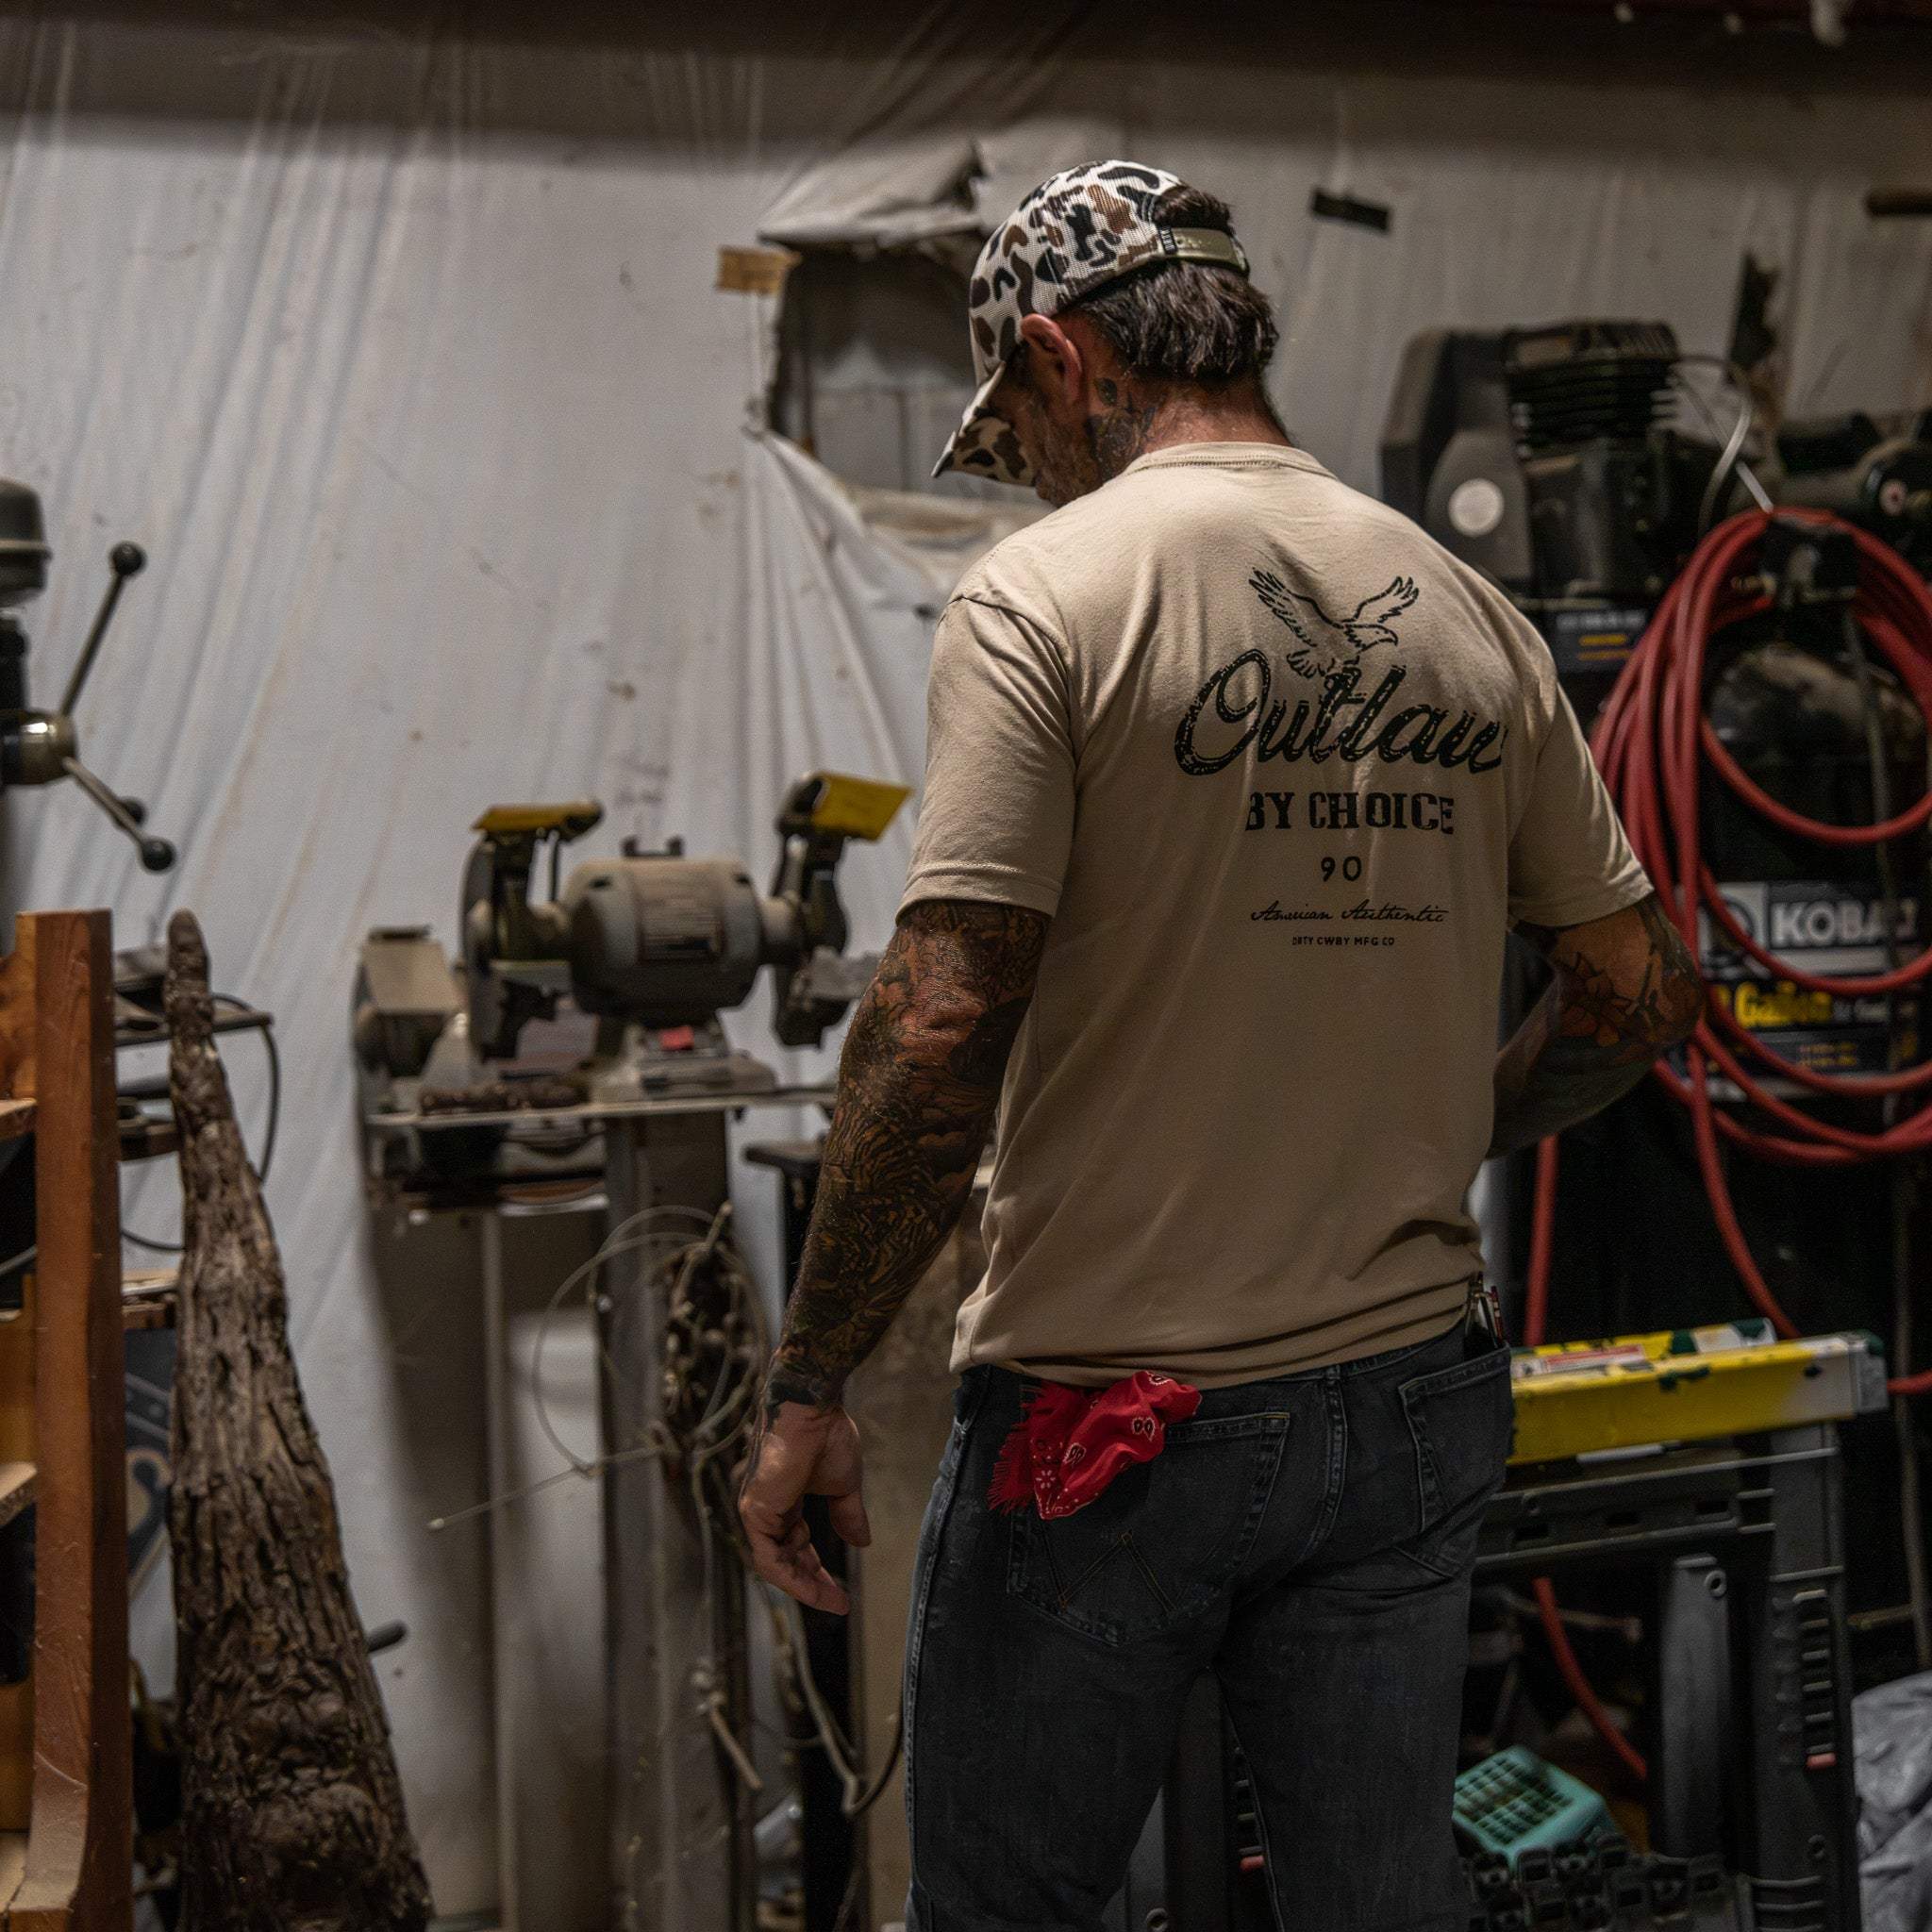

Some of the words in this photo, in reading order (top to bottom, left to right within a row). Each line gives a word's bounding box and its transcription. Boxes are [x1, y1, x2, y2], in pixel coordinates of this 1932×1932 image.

[1174, 648, 1508, 776] Outlaw
[1245, 791, 1295, 831] BY
[1308, 791, 1455, 835] CHOICE
[1320, 856, 1363, 883] 90
[1341, 898, 1450, 923] Authentic
[1354, 935, 1378, 946] MFG
[1382, 935, 1395, 946] CO
